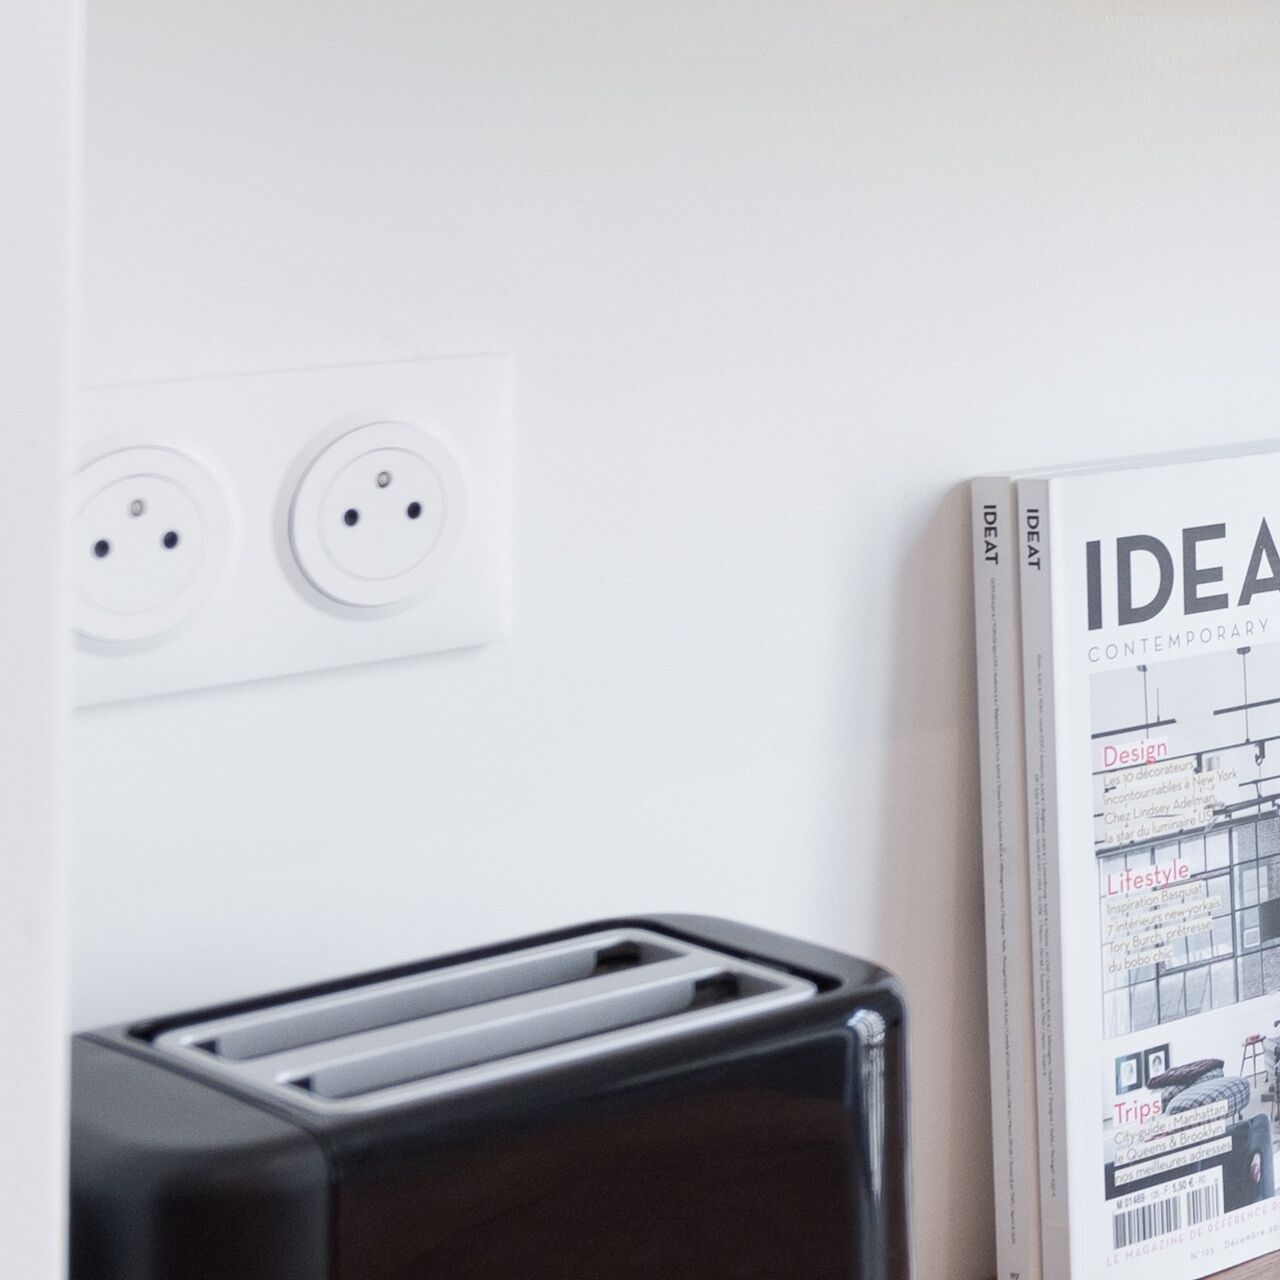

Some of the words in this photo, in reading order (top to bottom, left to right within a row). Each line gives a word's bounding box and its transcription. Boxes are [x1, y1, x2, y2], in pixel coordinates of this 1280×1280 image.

[984, 504, 998, 566] IDEAT
[1027, 508, 1041, 571] IDEAT
[1087, 617, 1270, 663] CONTEMPORARY
[1104, 740, 1168, 768] Design
[1136, 760, 1194, 781] décorateurs
[1105, 780, 1182, 806] incontournables
[1193, 775, 1214, 788] New
[1216, 767, 1238, 781] York
[1105, 812, 1130, 825] Chez
[1133, 803, 1171, 820] Lindsey
[1117, 829, 1135, 842] star
[1137, 824, 1150, 838] du
[1152, 815, 1196, 835] luminaire
[1107, 858, 1189, 896] Lifestyle
[1107, 895, 1159, 914] Inspiration
[1161, 884, 1203, 903] Basquiat
[1115, 914, 1163, 931] intérieurs
[1108, 940, 1131, 955] Tory
[1108, 960, 1122, 974] du
[1124, 955, 1151, 969] bobo
[1153, 948, 1174, 962] chic
[1114, 1100, 1160, 1125] Trips
[1115, 1171, 1133, 1184] nos
[1135, 1155, 1187, 1177] meilleures
[1190, 1140, 1232, 1162] adresses
[1126, 1144, 1167, 1161] Queens
[1168, 1138, 1177, 1149] &
[1107, 1256, 1121, 1267] LE
[1125, 1233, 1184, 1261] MAGAZINE
[1190, 1229, 1202, 1242] DE
